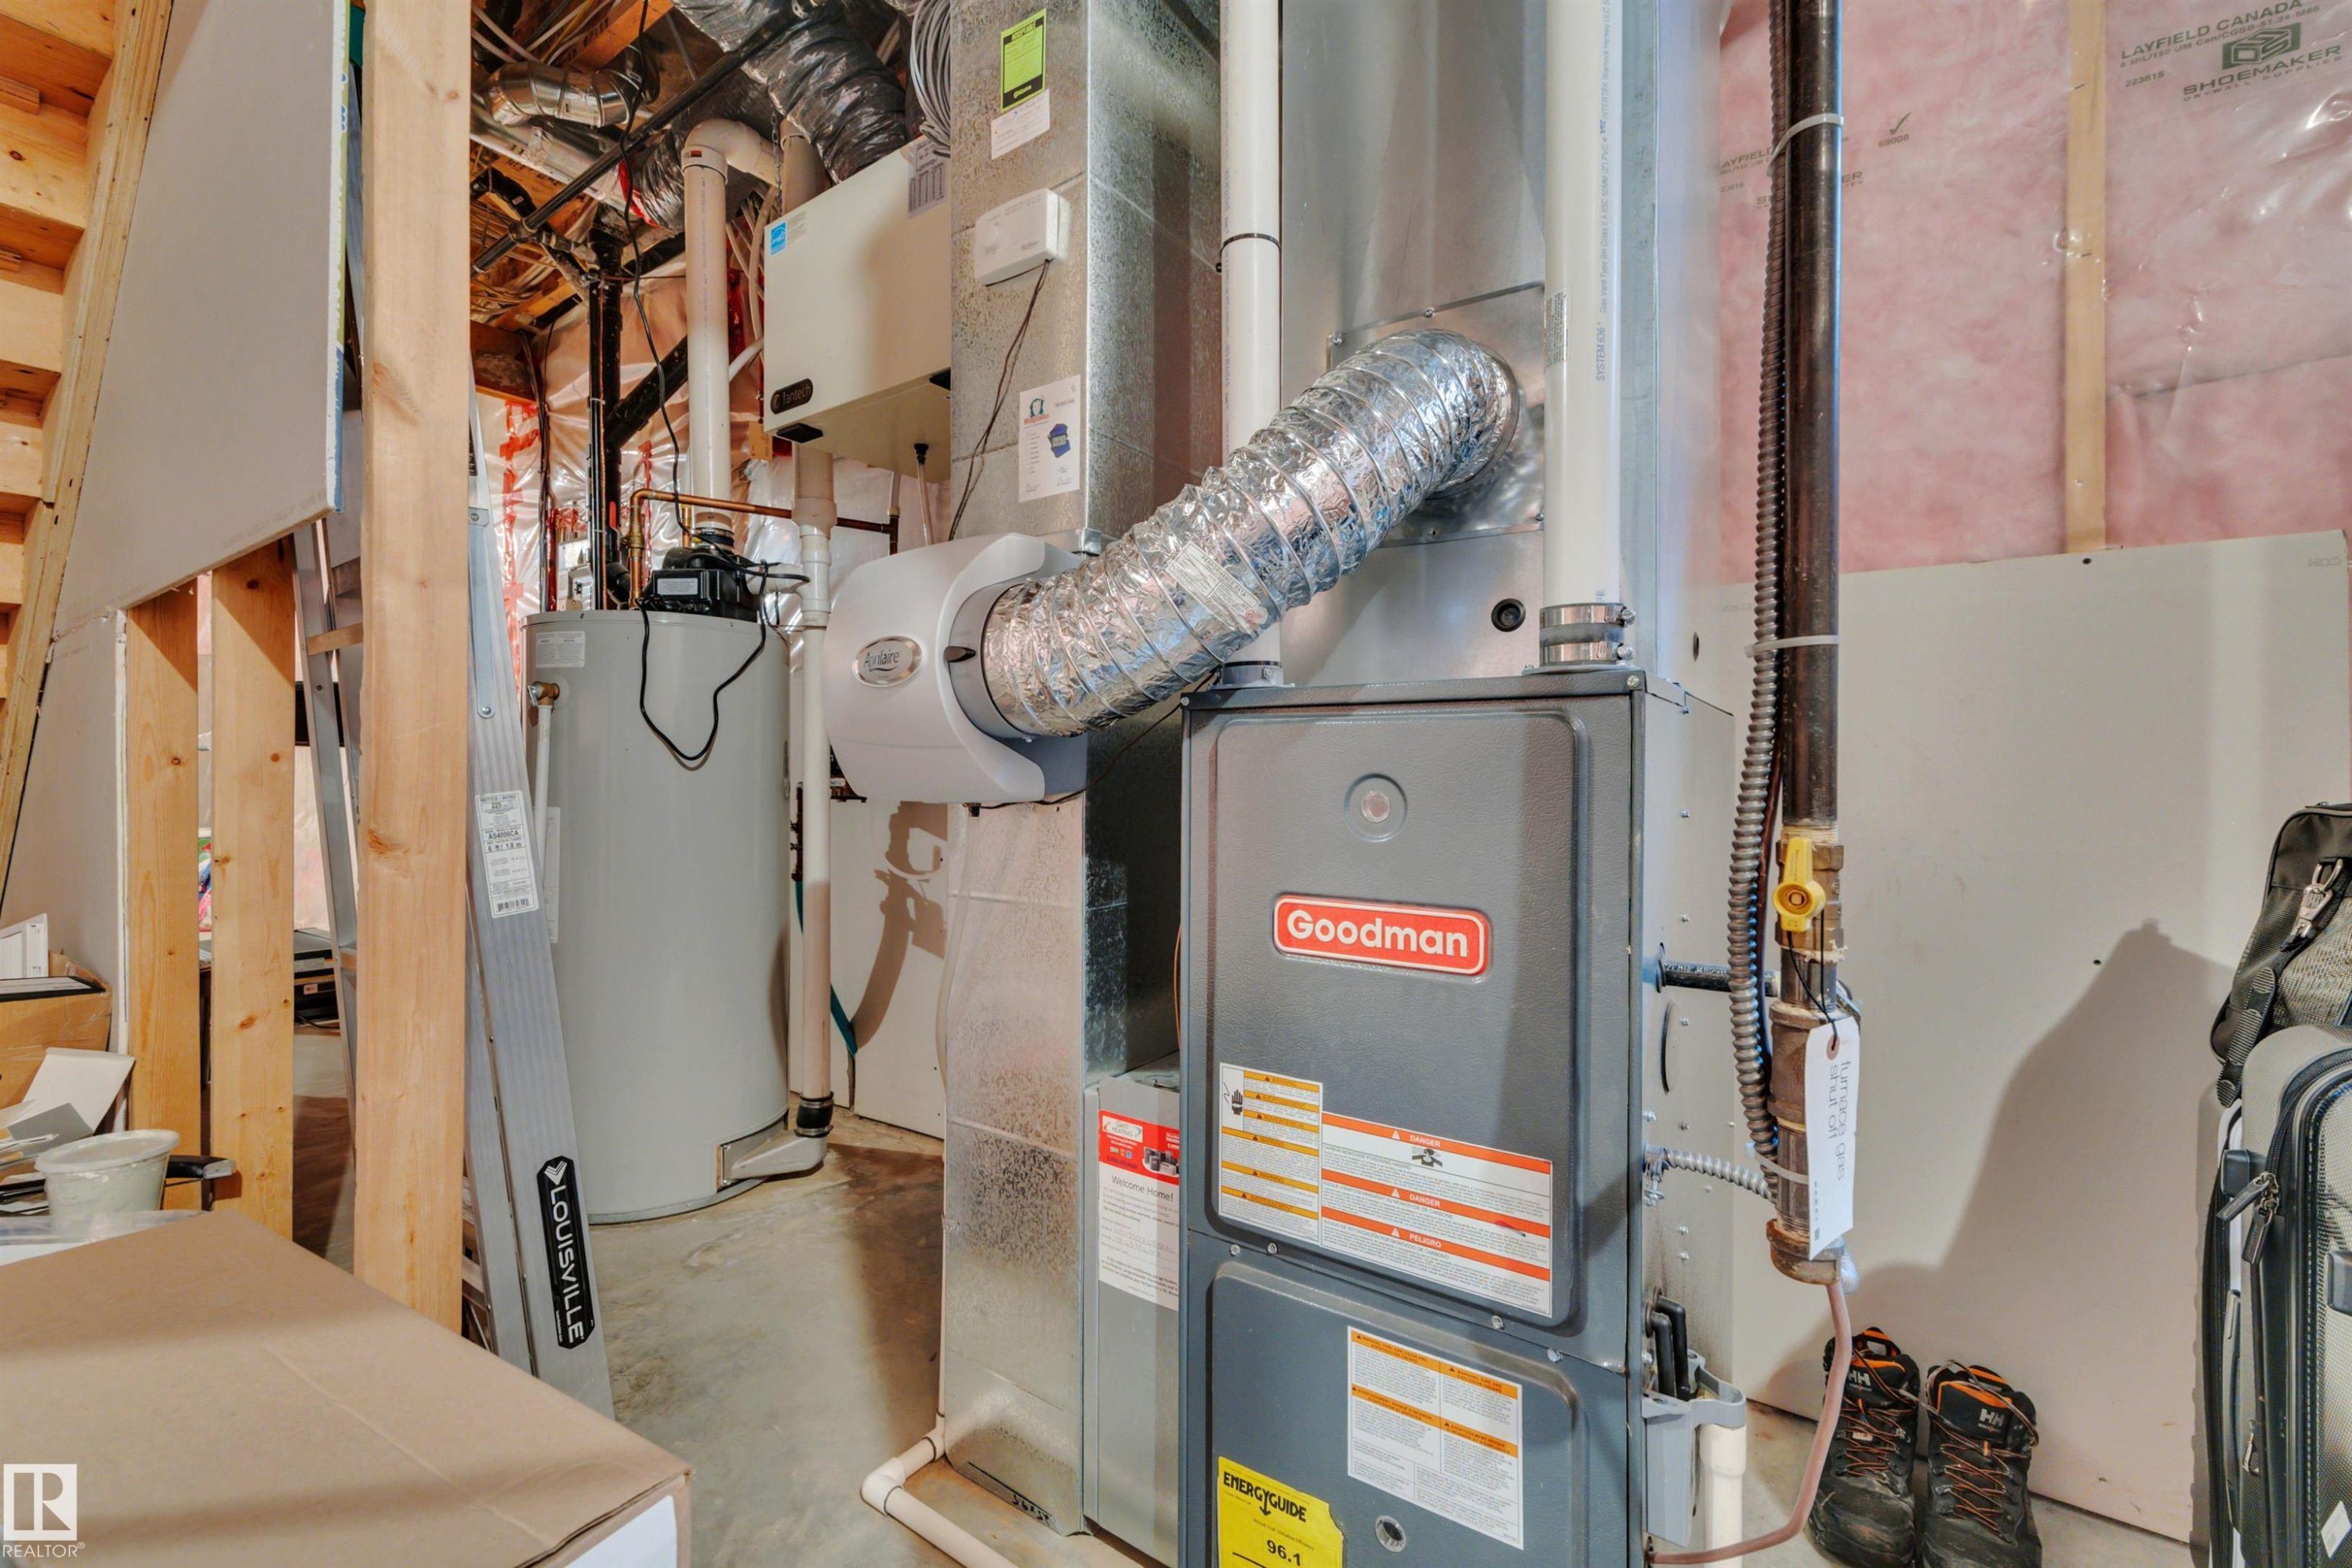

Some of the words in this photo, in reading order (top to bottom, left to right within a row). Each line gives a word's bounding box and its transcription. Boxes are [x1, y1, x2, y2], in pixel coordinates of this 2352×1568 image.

[2121, 25, 2210, 60] LAYFIELD
[2216, 0, 2303, 31] CANADA
[2174, 42, 2193, 53] UM
[2125, 71, 2165, 87] 223815
[2183, 45, 2342, 96] SHOEMAKER
[2183, 81, 2251, 102] DRYWALL
[2262, 56, 2343, 80] SUPPLIES
[1878, 133, 1910, 148] 69008
[1721, 147, 1773, 169] AYFIELD
[1596, 344, 1605, 382] SYSTEM
[865, 649, 900, 672] Aprilaire
[1287, 909, 1468, 957] Goodman
[1829, 1064, 1840, 1109] shut
[1838, 1060, 1851, 1136] furnace
[1828, 1114, 1838, 1140] off
[1410, 1134, 1439, 1147] DANGER
[1835, 1142, 1846, 1181] gas
[1112, 1175, 1145, 1192] Welcome
[1147, 1187, 1174, 1202] Home!
[1410, 1193, 1439, 1207] DANGER
[1410, 1233, 1441, 1248] PELIGRO
[550, 1185, 584, 1344] LOUISVILLE
[1848, 1370, 1871, 1386] HH
[1980, 1408, 2004, 1427] HH
[1224, 1472, 1306, 1523] ENERGYGUIDE
[1267, 1540, 1301, 1566] 96.1
